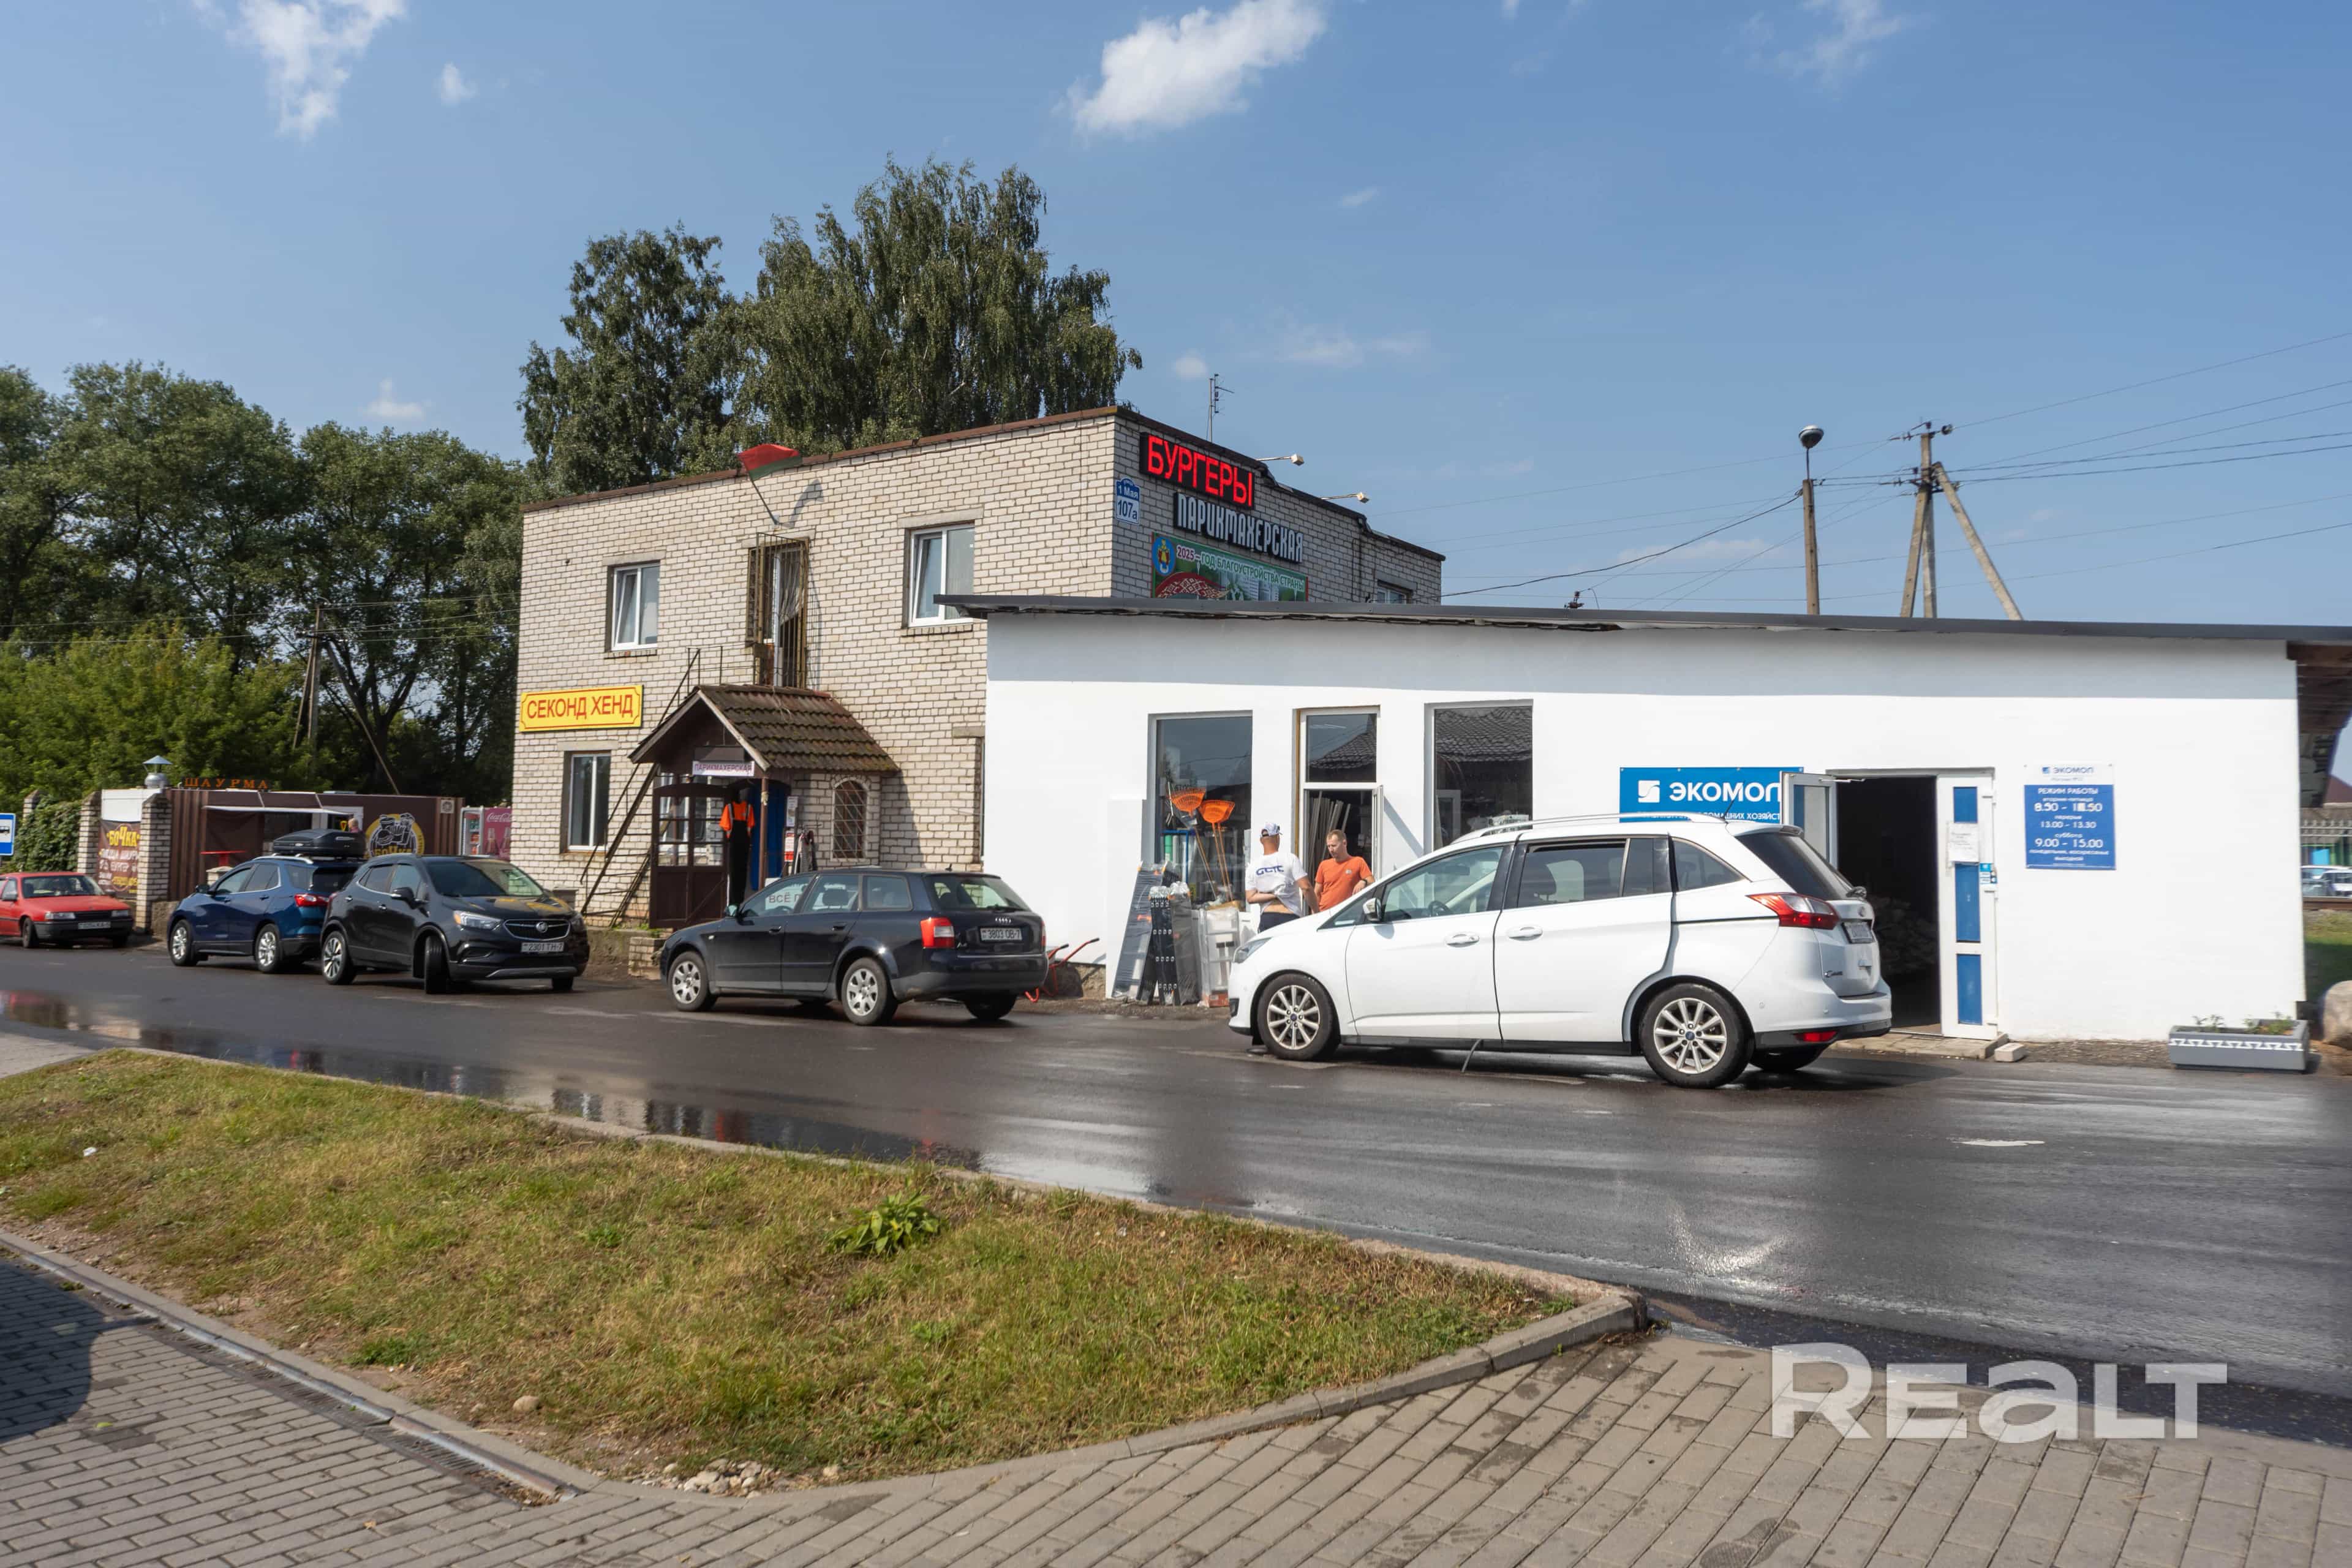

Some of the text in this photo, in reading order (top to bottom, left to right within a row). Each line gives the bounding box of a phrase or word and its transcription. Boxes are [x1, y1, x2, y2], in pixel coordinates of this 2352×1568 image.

[1148, 435, 1253, 507] БУРГЕРЫ
[1118, 484, 1138, 499] 1 Мая
[1178, 494, 1303, 563] ПАРИКМАХЕРСКАЯ
[1177, 546, 1194, 560] 2025
[1201, 552, 1216, 568] ГОД
[1217, 558, 1280, 584] БЛАГОУСТРОЙСТВА
[1280, 575, 1305, 591] СТРАНЫ
[527, 694, 633, 720] СЕКОНД ХЕНД
[695, 763, 752, 772] ПАРИКМАХЕРСКАЯ
[185, 777, 268, 789] ШАУРМА
[2073, 802, 2103, 812] 1.50
[108, 826, 137, 846] БОЧКА
[2035, 838, 2059, 847] 9.00
[2073, 839, 2104, 848] 15.00
[769, 891, 790, 903] ВСЁ
